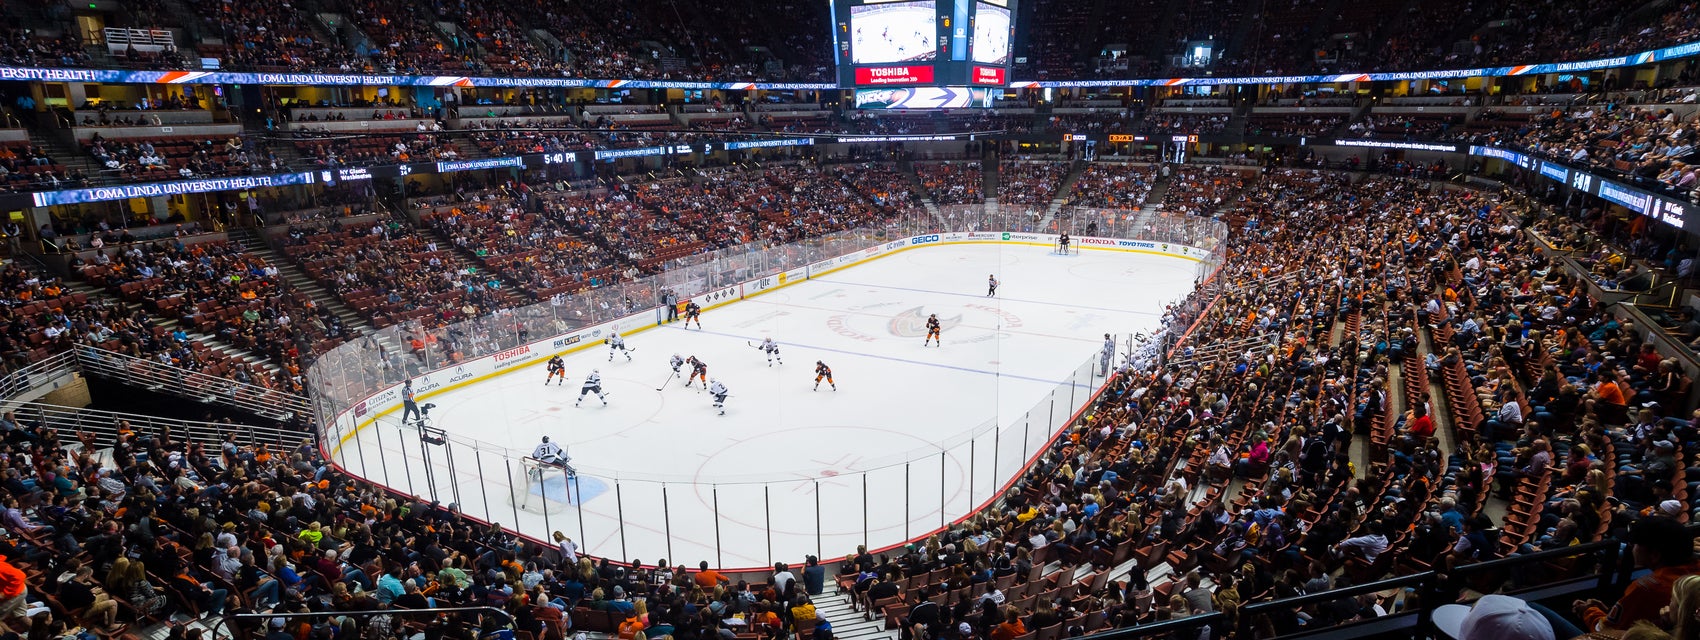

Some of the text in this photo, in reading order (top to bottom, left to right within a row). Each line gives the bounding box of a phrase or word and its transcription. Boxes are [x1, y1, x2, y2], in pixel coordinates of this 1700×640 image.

[46, 70, 96, 80] HEALTH
[870, 67, 909, 76] TOSHIBA
[1427, 70, 1460, 78] UNIVERSITY
[258, 74, 393, 85] LOMA LINDA UNIVERSITY HEALTH
[496, 78, 514, 86] LOMA
[544, 152, 576, 164] 5:40 PM
[340, 173, 371, 181] Washington
[89, 176, 272, 200] LOMA LINDA UNIVERSITY HEALTH
[912, 234, 939, 245] GEICO
[760, 277, 770, 289] Lite
[553, 339, 564, 347] FOX
[565, 334, 581, 346] LIVE
[493, 345, 530, 362] TOSHIBA
[494, 354, 532, 370] Leading Innovation
[449, 372, 473, 383] ACURA
[416, 382, 440, 394] ACURA
[540, 446, 551, 456] 31
[653, 575, 665, 585] 15
